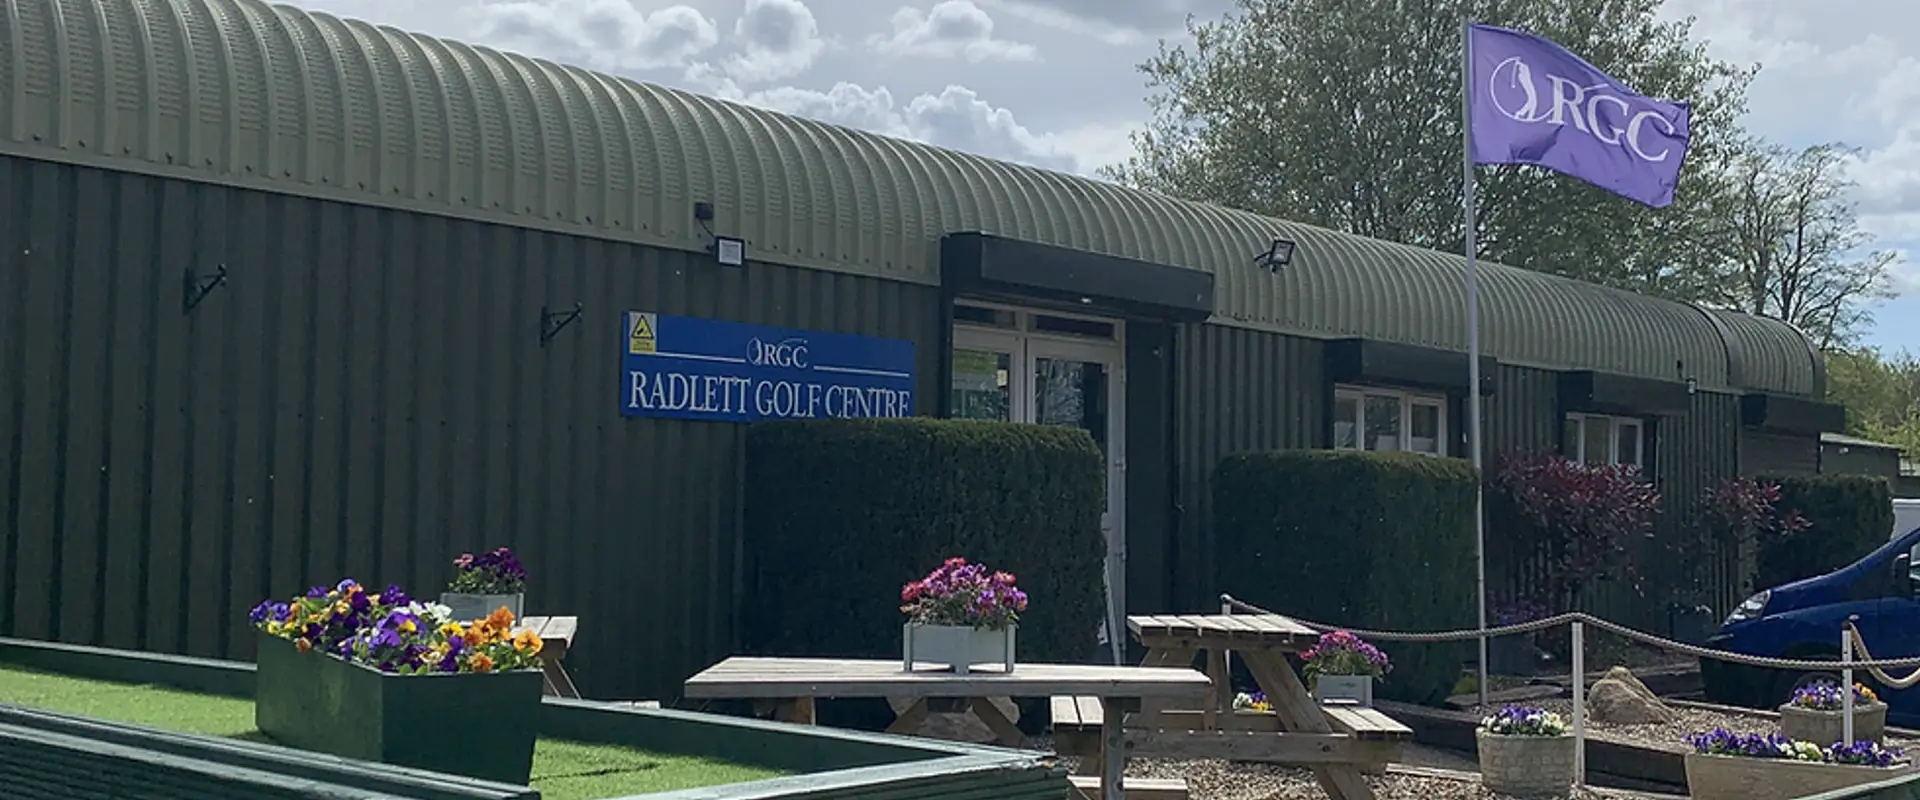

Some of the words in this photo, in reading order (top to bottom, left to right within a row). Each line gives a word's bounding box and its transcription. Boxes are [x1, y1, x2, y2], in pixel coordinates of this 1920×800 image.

[1546, 74, 1675, 162] RGC
[764, 343, 808, 369] RGC
[628, 371, 751, 414] RADLETT
[756, 380, 822, 417] GOLF
[825, 385, 910, 419] CENTRE
